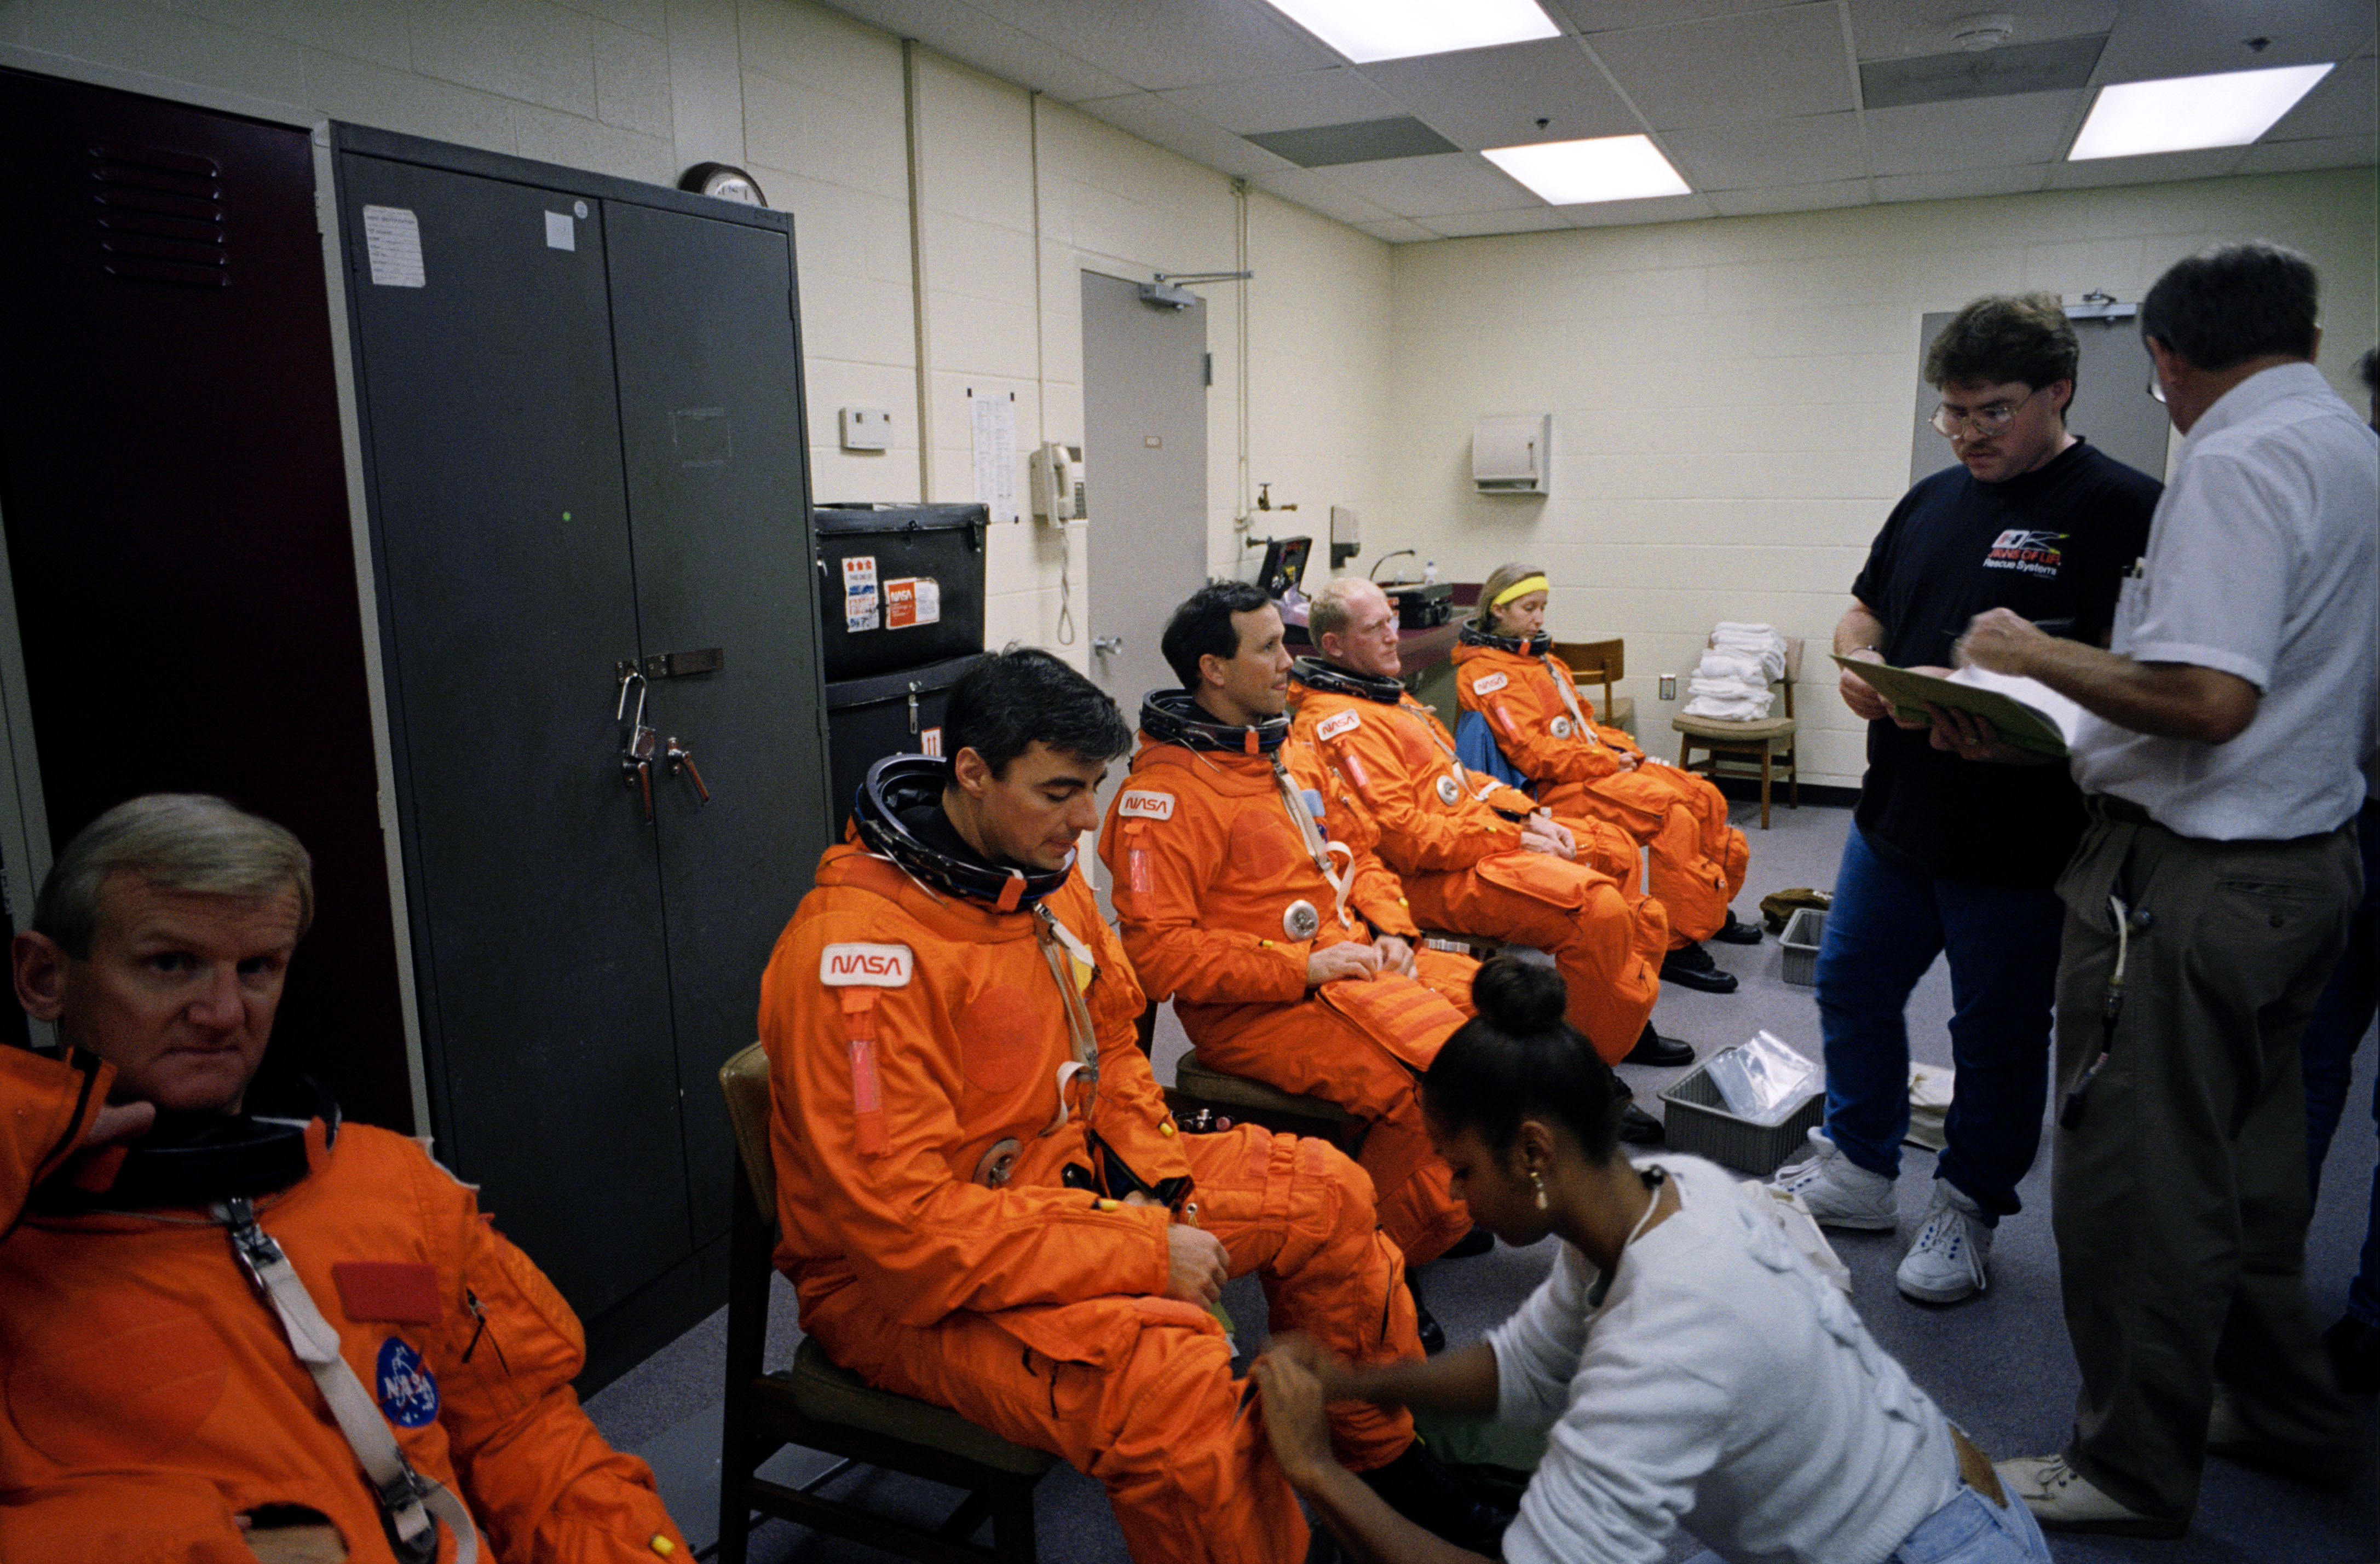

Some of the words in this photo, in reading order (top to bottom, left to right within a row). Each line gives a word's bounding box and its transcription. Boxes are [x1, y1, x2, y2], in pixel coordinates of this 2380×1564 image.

[1983, 557, 2016, 569] Rescue
[2021, 549, 2038, 561] OF
[890, 589, 913, 603] NASA
[1477, 676, 1504, 691] NASA
[1322, 715, 1355, 735] NASA
[1125, 797, 1167, 814] NASA
[831, 954, 902, 976] NASA
[384, 1373, 435, 1406] NASA
